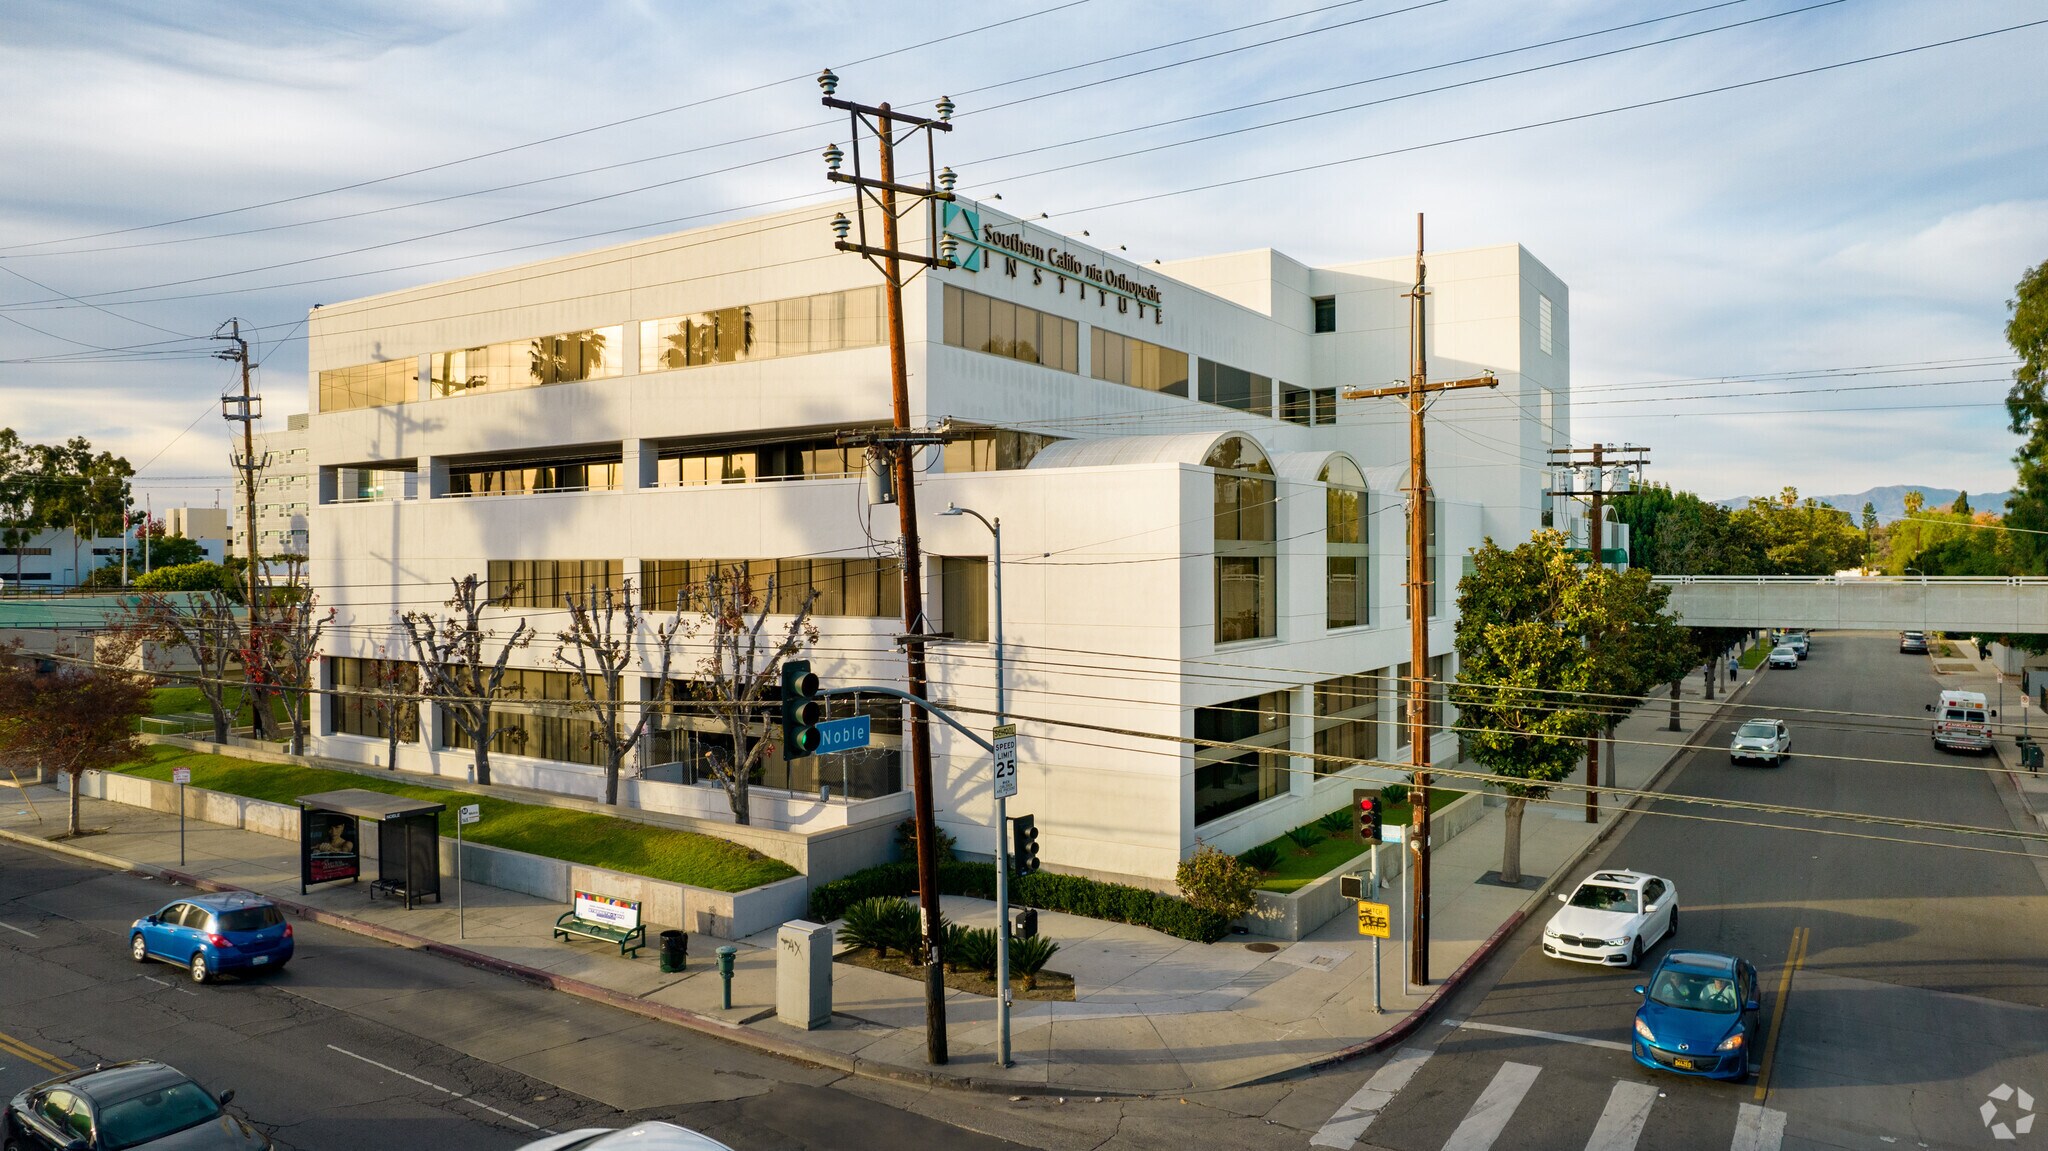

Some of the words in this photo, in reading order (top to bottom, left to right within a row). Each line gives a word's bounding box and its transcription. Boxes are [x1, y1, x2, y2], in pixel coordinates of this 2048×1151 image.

[984, 223, 1044, 262] Southern
[1048, 247, 1103, 283] Califonia
[1105, 269, 1162, 304] Orthopedic
[983, 249, 1163, 325] INSTITUTE
[822, 726, 864, 746] Noble
[996, 742, 1014, 751] SPEED
[998, 750, 1012, 760] LIMIT
[996, 759, 1015, 778] 25
